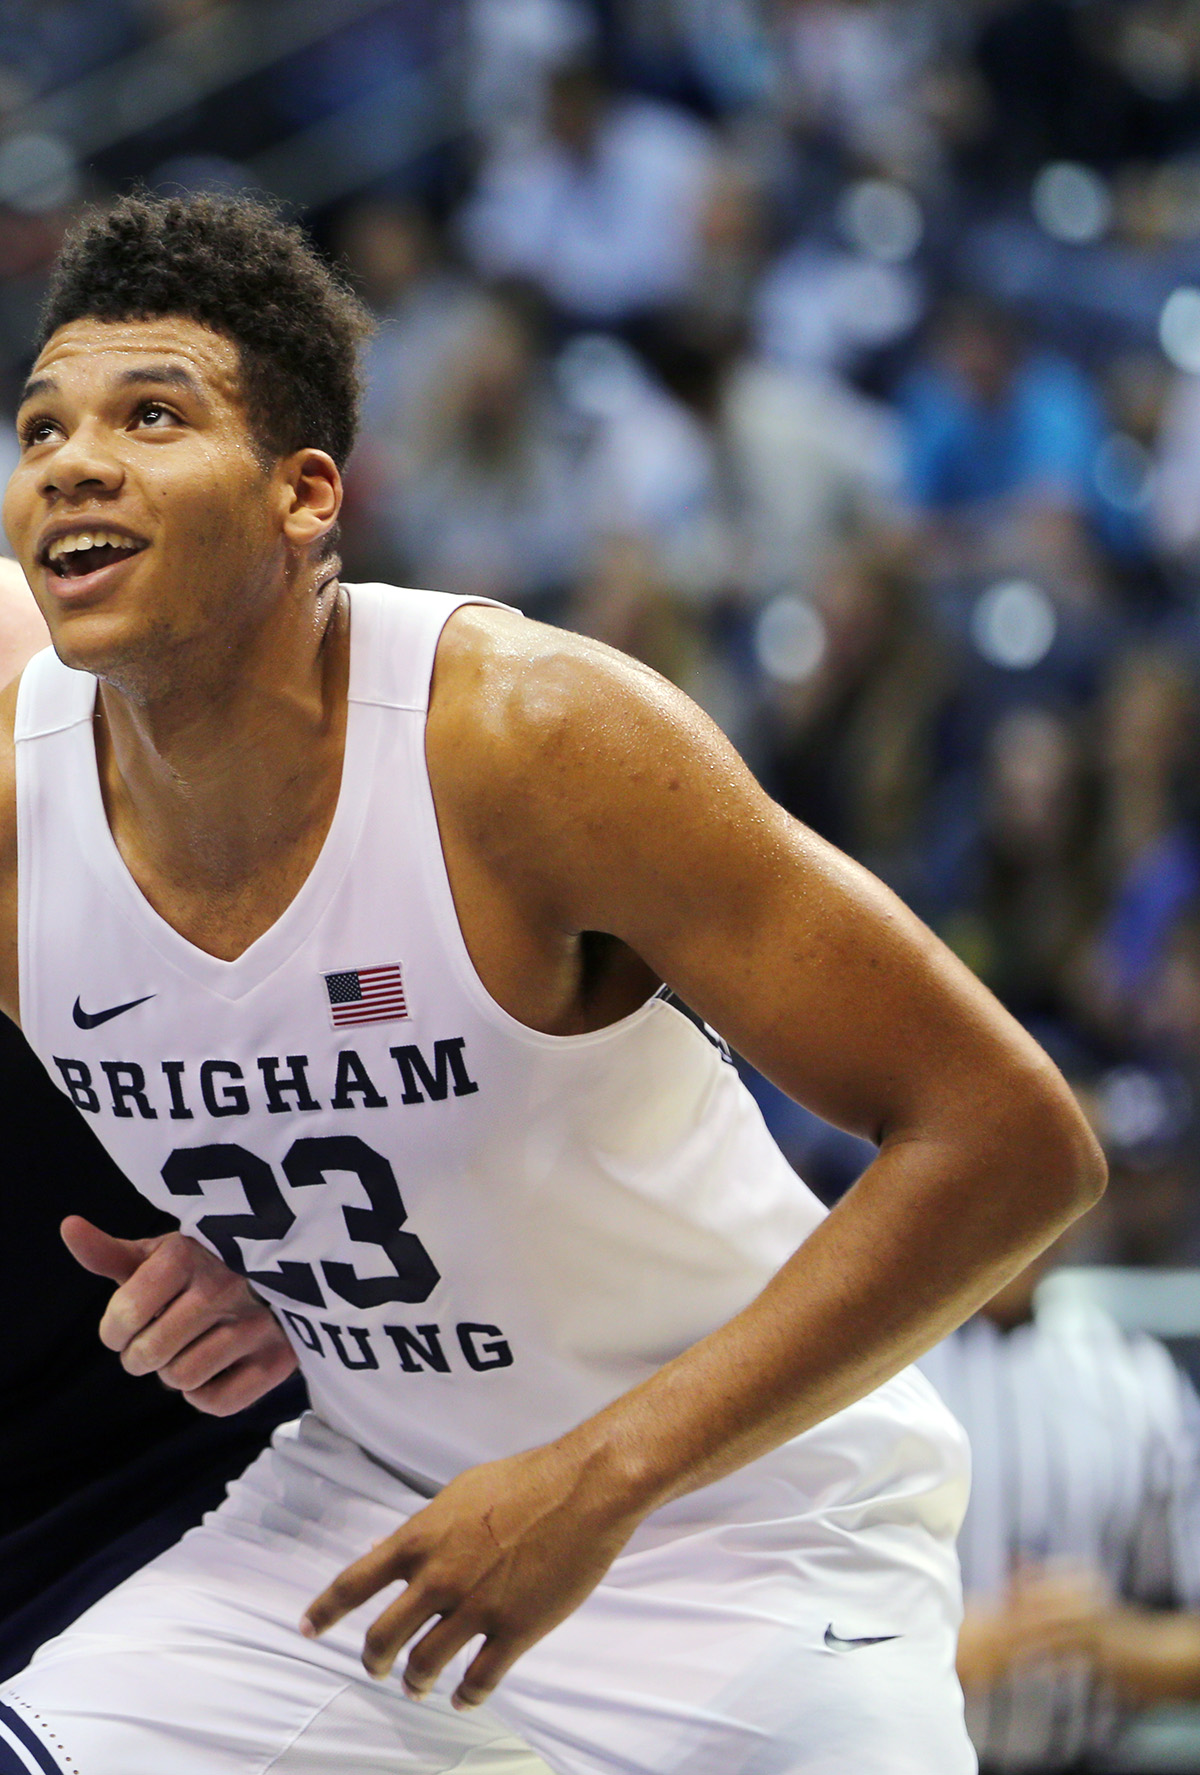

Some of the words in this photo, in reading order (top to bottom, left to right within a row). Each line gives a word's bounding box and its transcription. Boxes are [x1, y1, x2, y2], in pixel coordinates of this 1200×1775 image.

[52, 1036, 479, 1120] BRIGHAM
[160, 1135, 442, 1310] 23
[282, 1308, 515, 1374] OUNG
